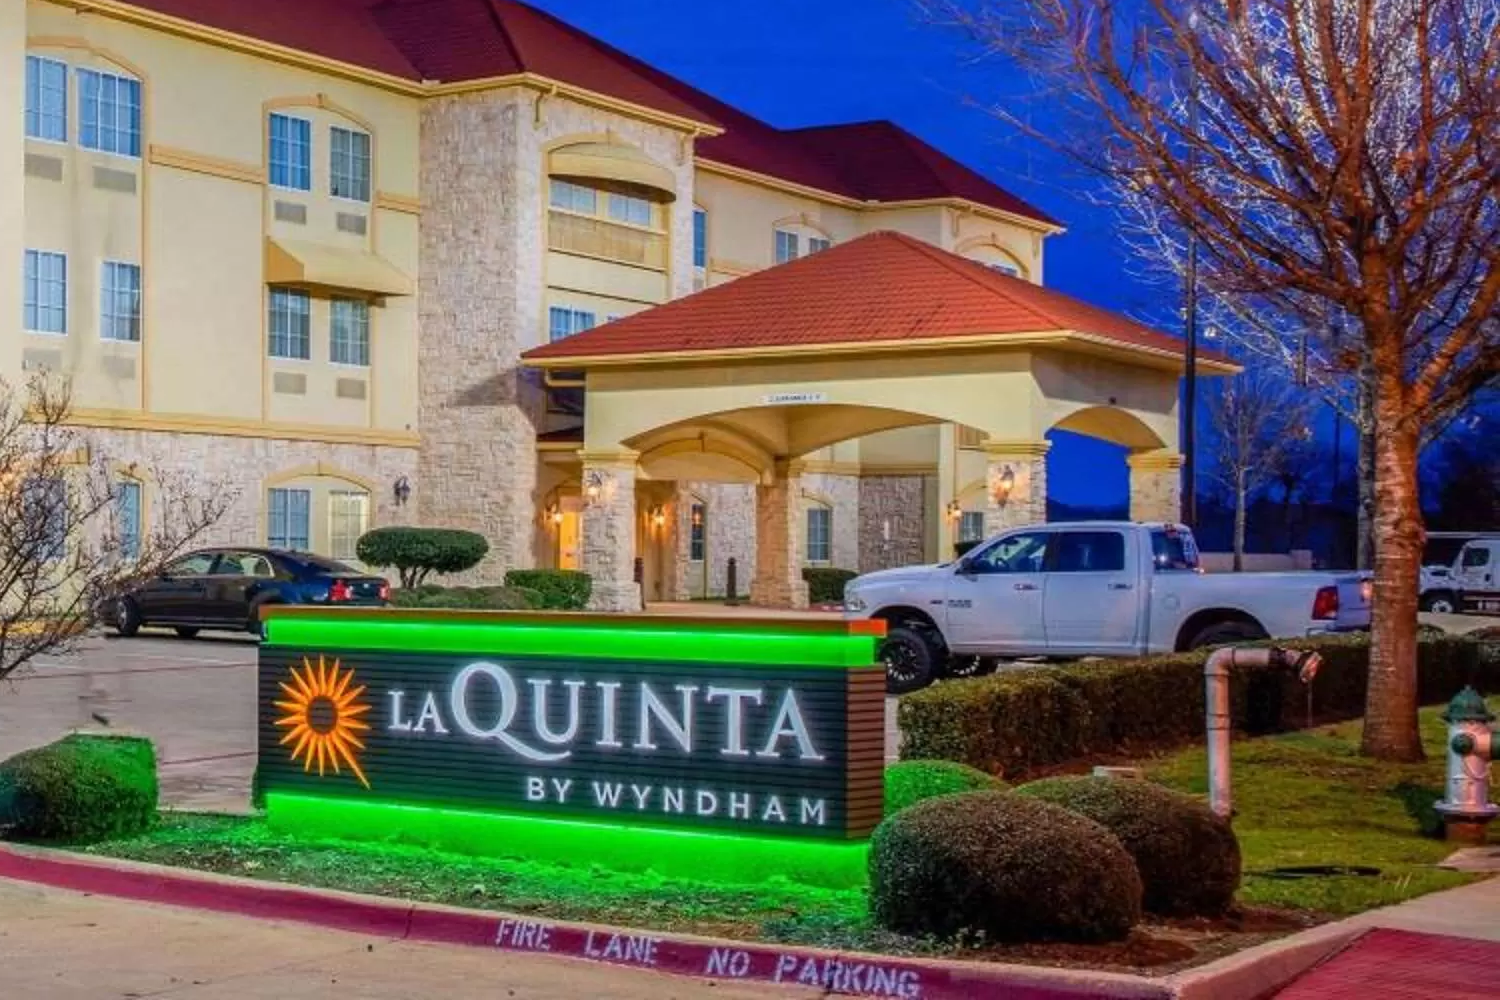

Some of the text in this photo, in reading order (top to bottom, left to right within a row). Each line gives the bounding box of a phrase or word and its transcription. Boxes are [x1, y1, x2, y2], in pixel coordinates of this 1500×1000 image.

[388, 661, 826, 762] LA QUINTA
[526, 777, 827, 827] BY WYNDHAM
[495, 919, 921, 998] FIRE LANE NO PARKING
